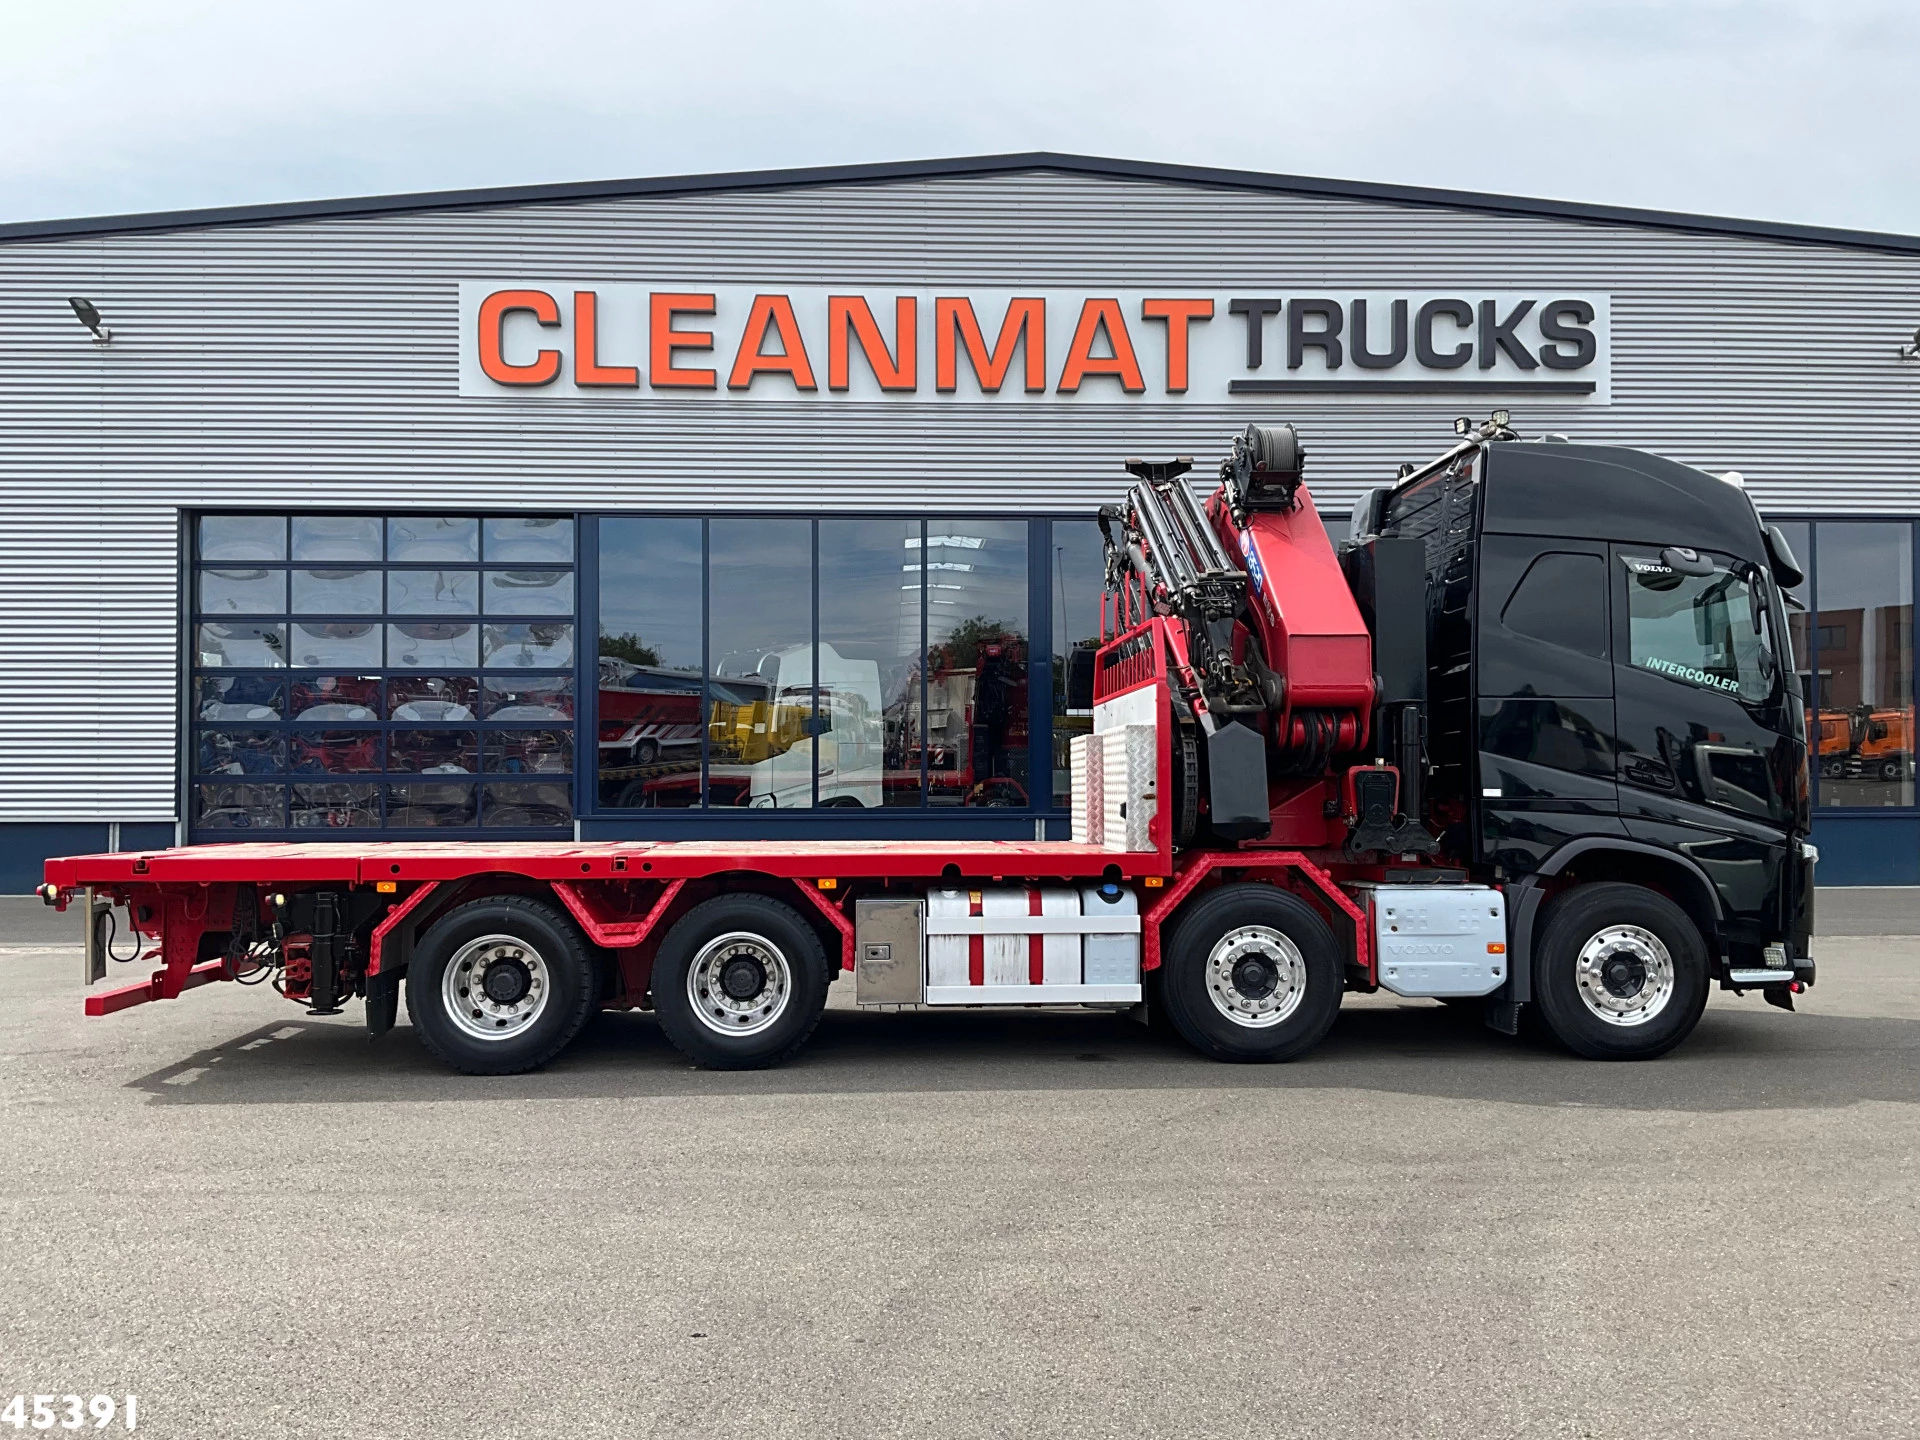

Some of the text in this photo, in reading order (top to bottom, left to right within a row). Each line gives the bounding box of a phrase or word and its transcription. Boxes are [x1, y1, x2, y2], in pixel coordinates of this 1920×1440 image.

[478, 289, 1597, 394] CLEANMAT TRUCKS
[1634, 563, 1673, 574] VOLVO
[1645, 656, 1740, 693] INTERCOOLER
[1387, 943, 1454, 955] VOLVO
